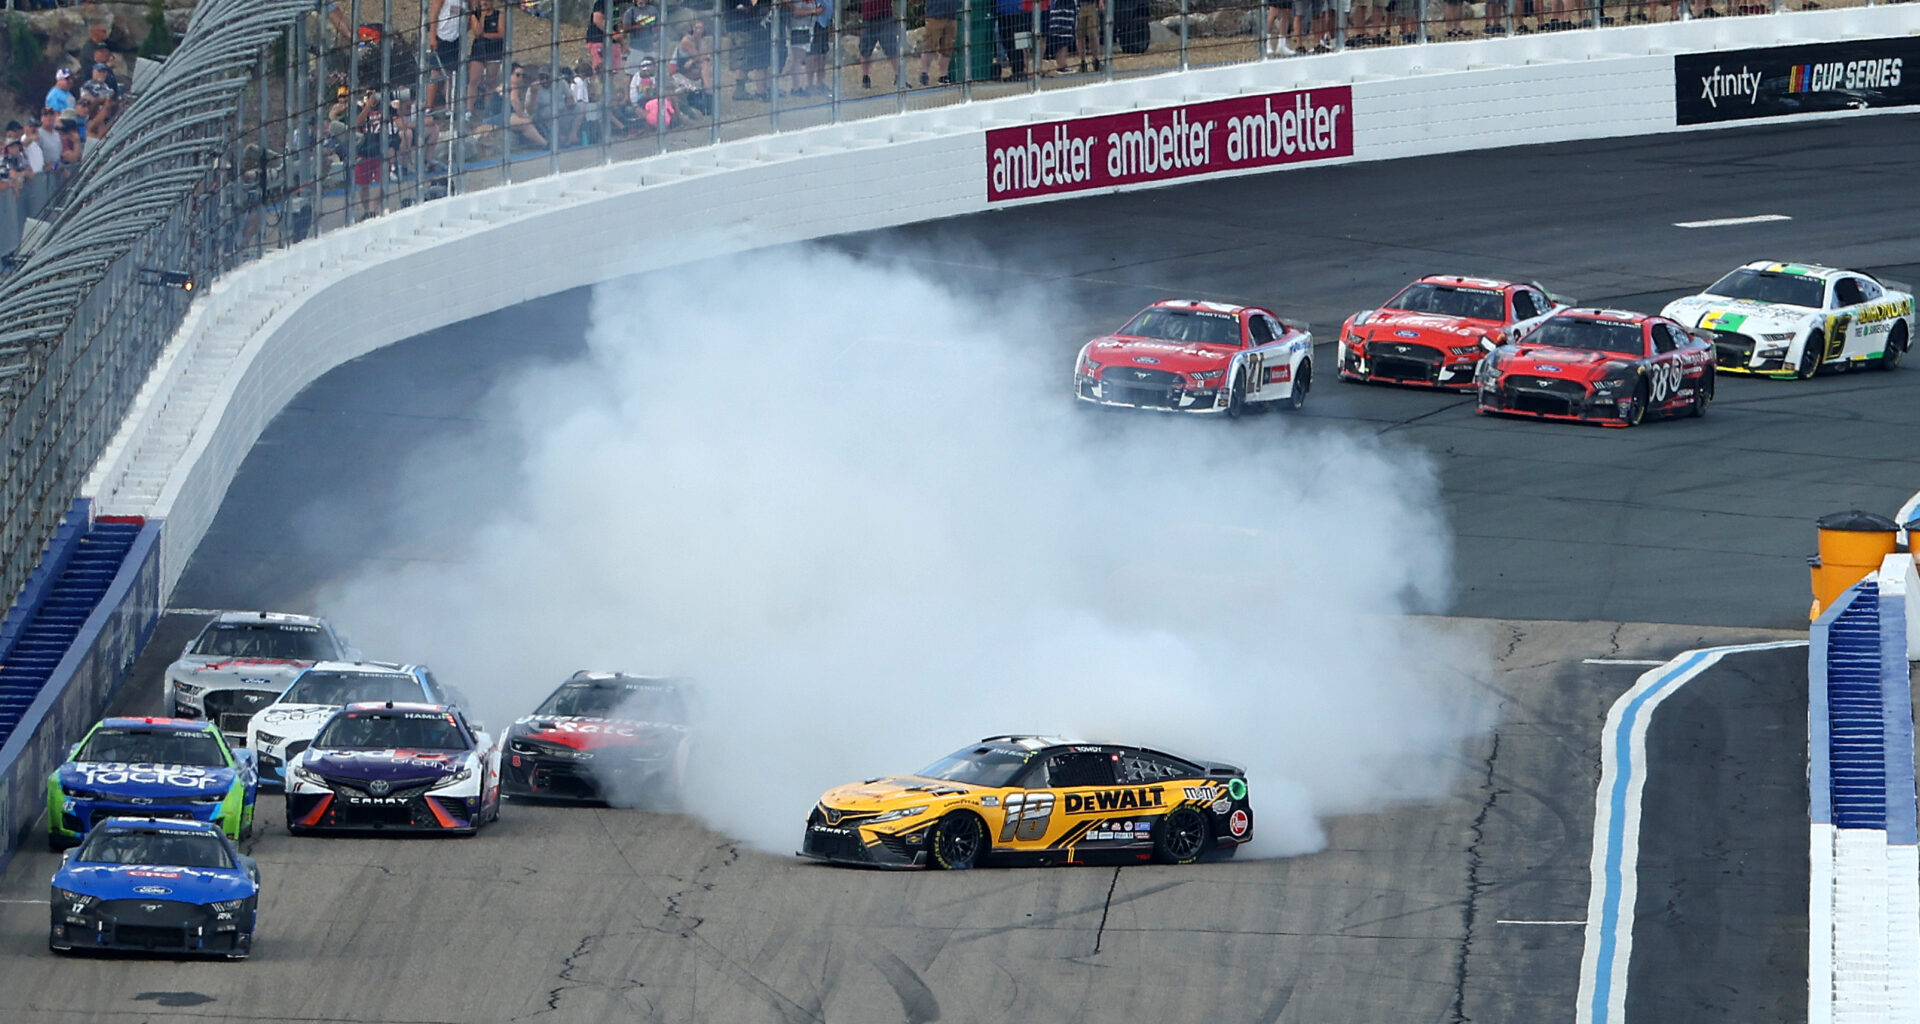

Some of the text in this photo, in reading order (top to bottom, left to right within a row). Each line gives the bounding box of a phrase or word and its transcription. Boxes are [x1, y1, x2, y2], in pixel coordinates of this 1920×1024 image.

[1701, 64, 1762, 108] xfinity
[1812, 57, 1903, 92] CUP SERIES
[993, 92, 1341, 193] ambetter ambetter ambetter
[1195, 311, 1231, 320] BURTON
[1247, 352, 1264, 393] 21
[1649, 362, 1671, 402] 38
[173, 730, 211, 739] JONES
[350, 797, 409, 805] CAMRY
[998, 791, 1056, 843] 18
[813, 825, 851, 836] CAMRY
[72, 902, 84, 913] 17
